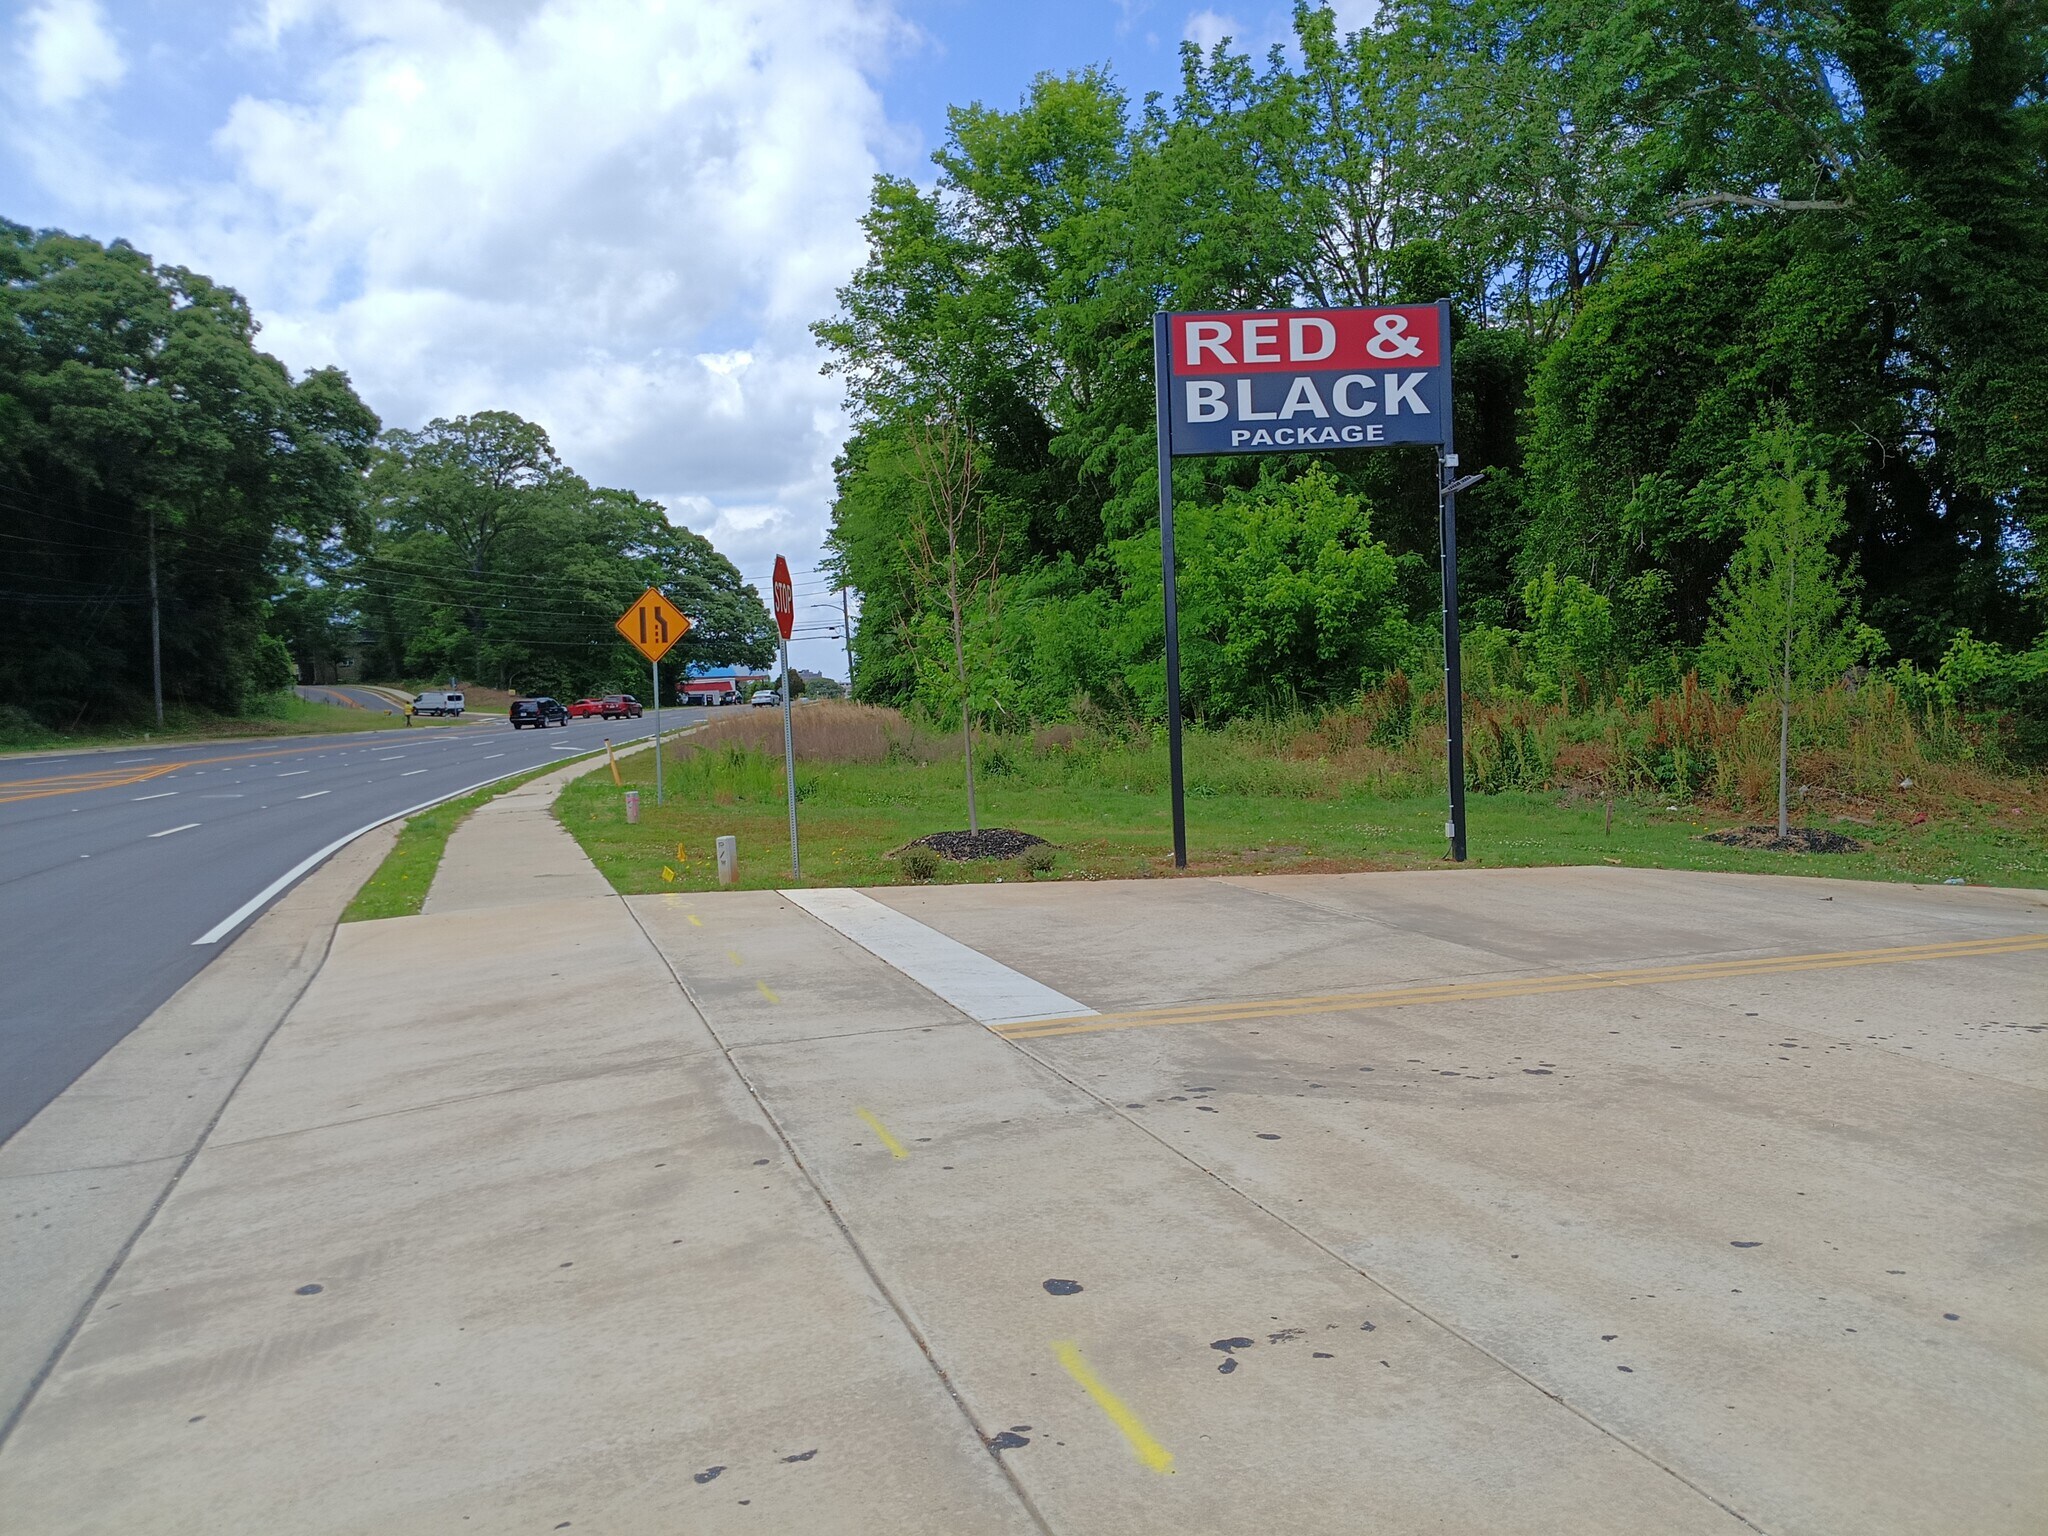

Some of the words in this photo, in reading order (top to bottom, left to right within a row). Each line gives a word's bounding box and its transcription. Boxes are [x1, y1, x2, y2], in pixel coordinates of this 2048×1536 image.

[1185, 318, 1336, 365] RED
[1366, 314, 1424, 359] &
[1185, 372, 1430, 423] BLACK
[1231, 424, 1384, 446] PACKAGE
[774, 581, 791, 613] STOP
